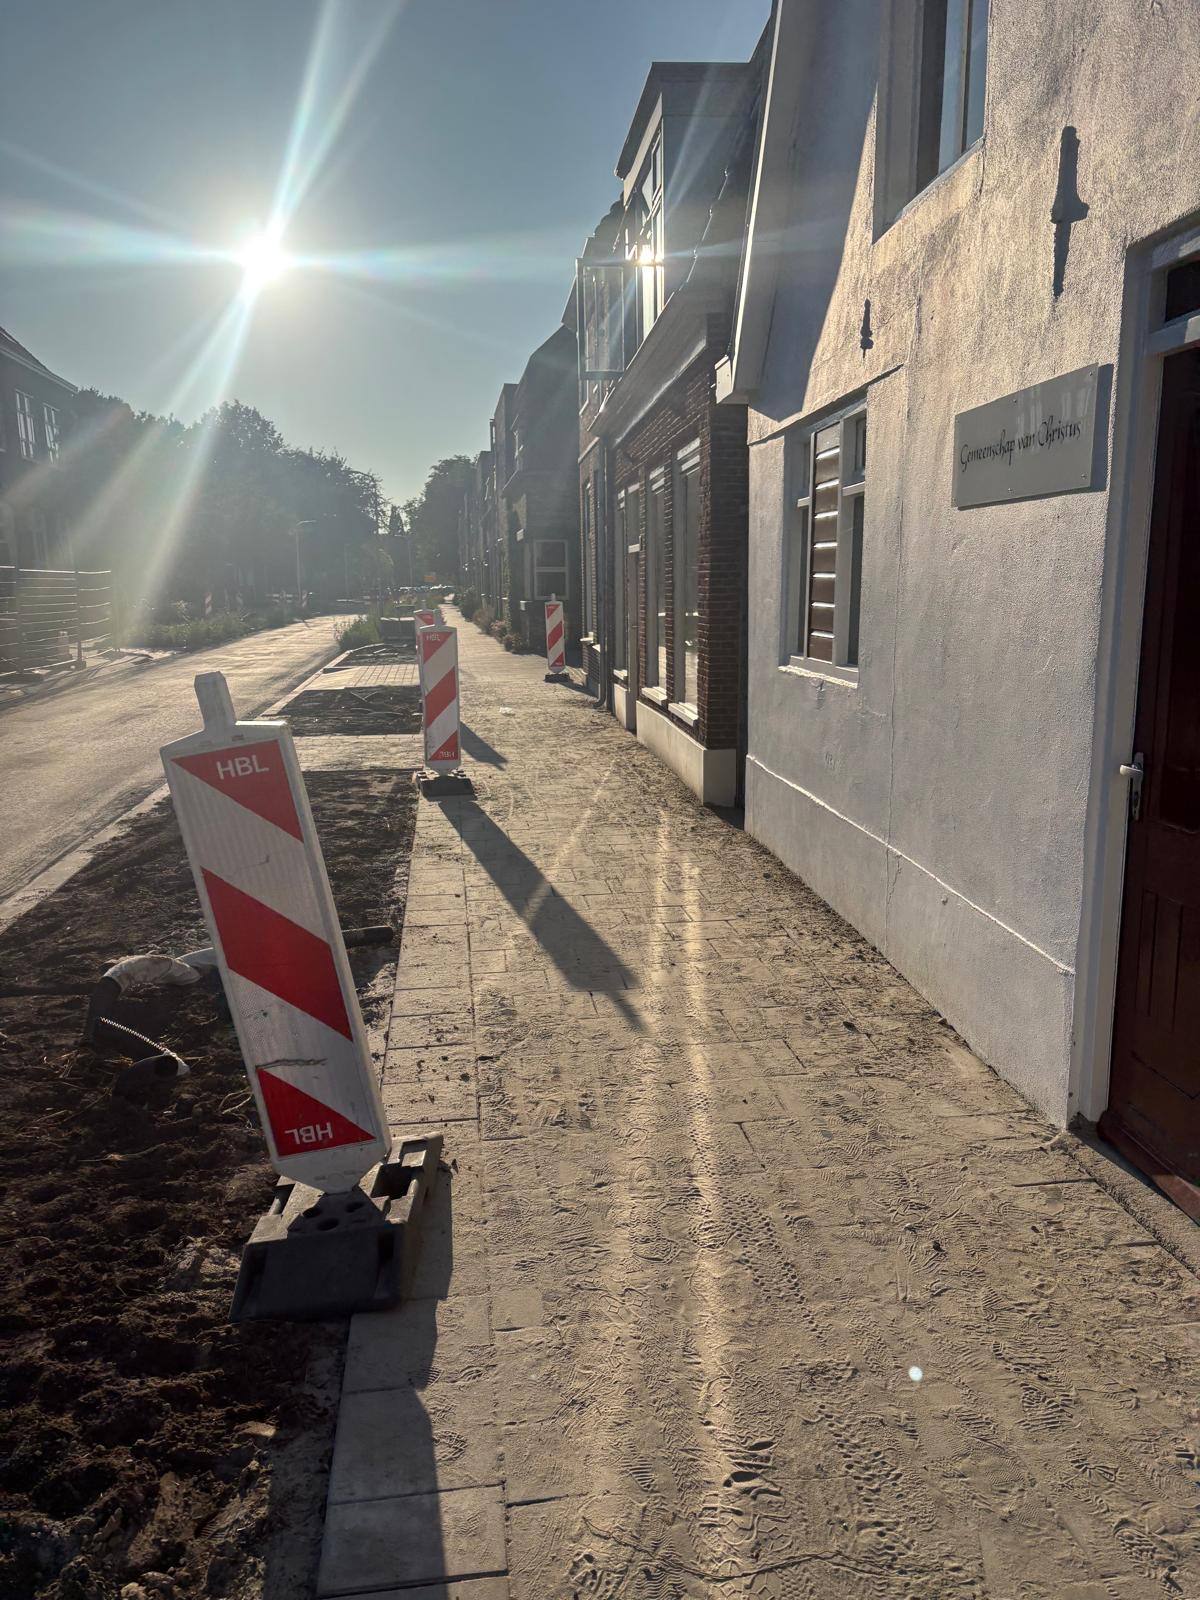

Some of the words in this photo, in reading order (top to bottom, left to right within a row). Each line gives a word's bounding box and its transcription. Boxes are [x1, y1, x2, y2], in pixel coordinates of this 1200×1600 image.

[960, 429, 1015, 472] Gemeenschap
[1018, 432, 1035, 450] van
[1038, 415, 1081, 450] Christus
[216, 754, 269, 780] HBL
[284, 1122, 333, 1145] HBL
